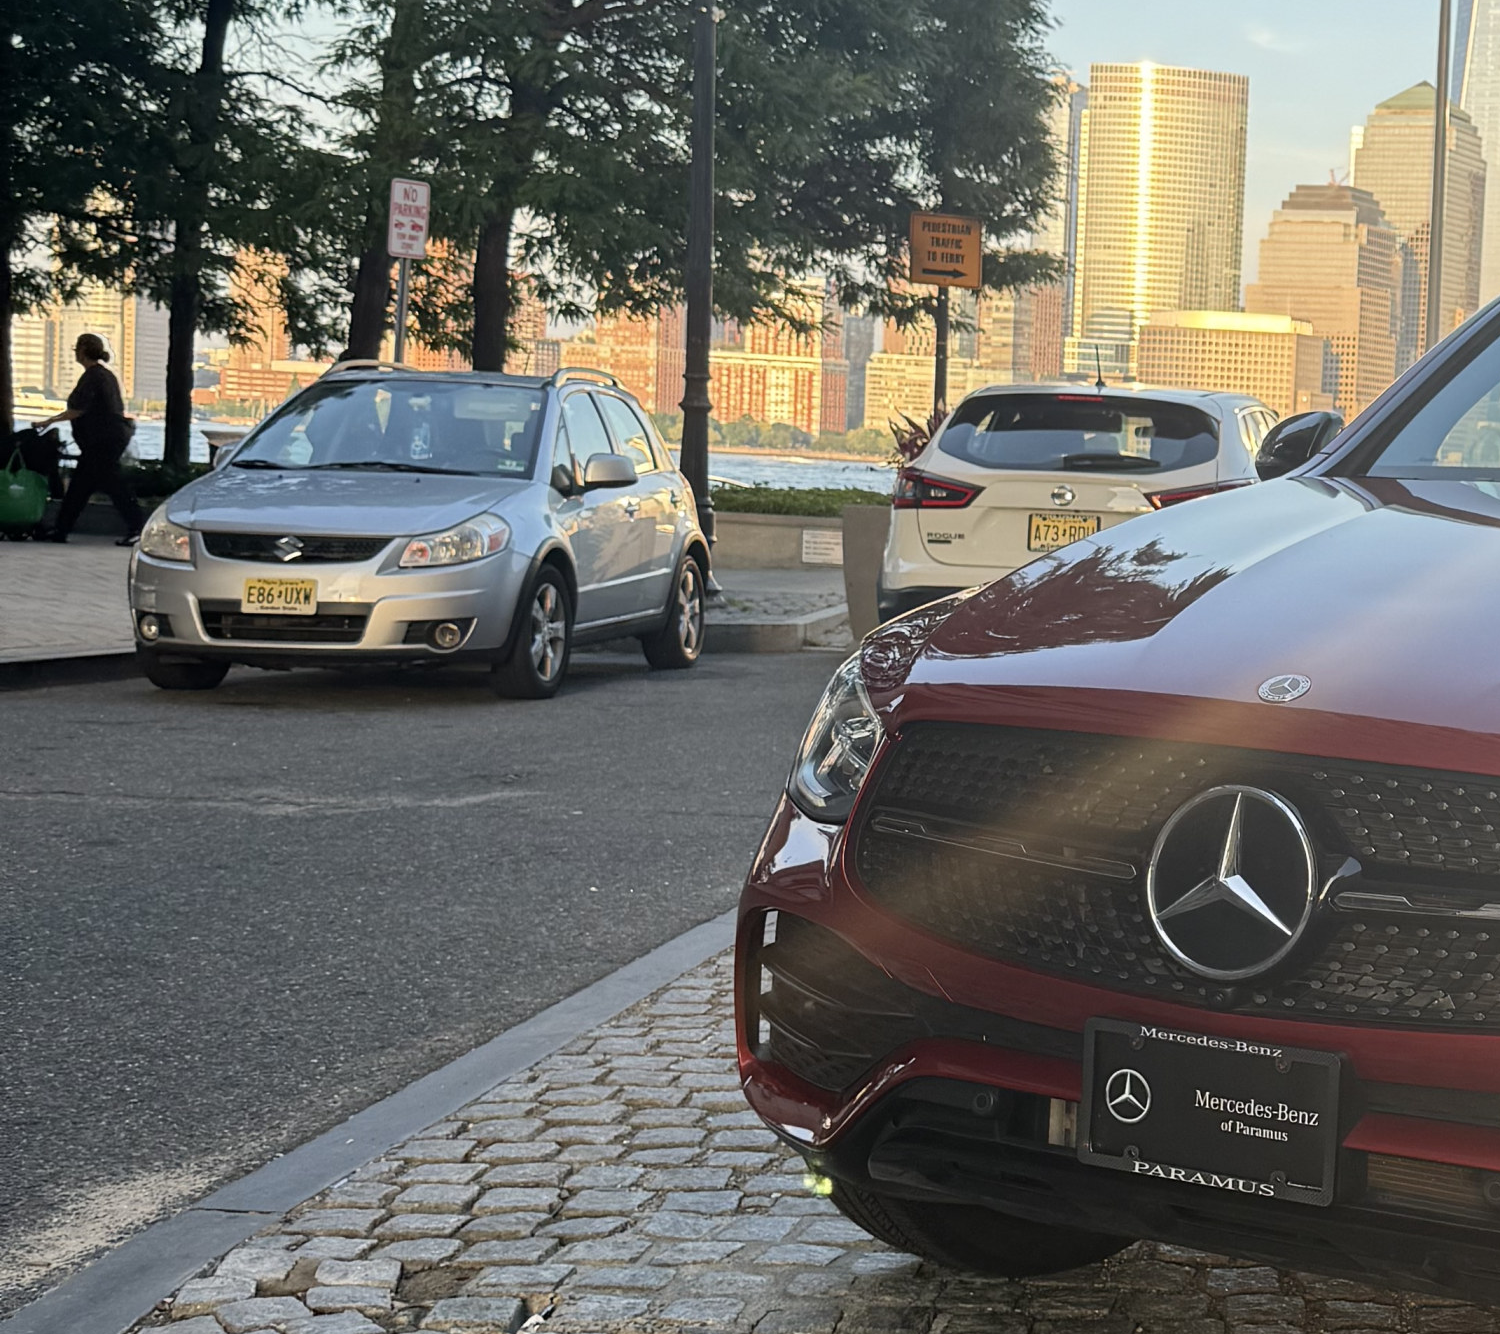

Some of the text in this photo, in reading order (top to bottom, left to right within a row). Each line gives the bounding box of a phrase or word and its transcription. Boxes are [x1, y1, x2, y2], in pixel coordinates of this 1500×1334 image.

[403, 187, 418, 203] NO
[393, 202, 426, 219] PARKING
[922, 221, 971, 235] PEDESTRIAN
[931, 236, 963, 249] TRAFFIC
[928, 250, 965, 264] TO FERRY
[927, 532, 965, 540] ROGUE
[1140, 1025, 1283, 1058] Mercedes-Benz
[1194, 1089, 1319, 1126] Mercedes-Benz
[1220, 1120, 1289, 1142] of Paramus
[1132, 1160, 1275, 1197] PARAMUS
